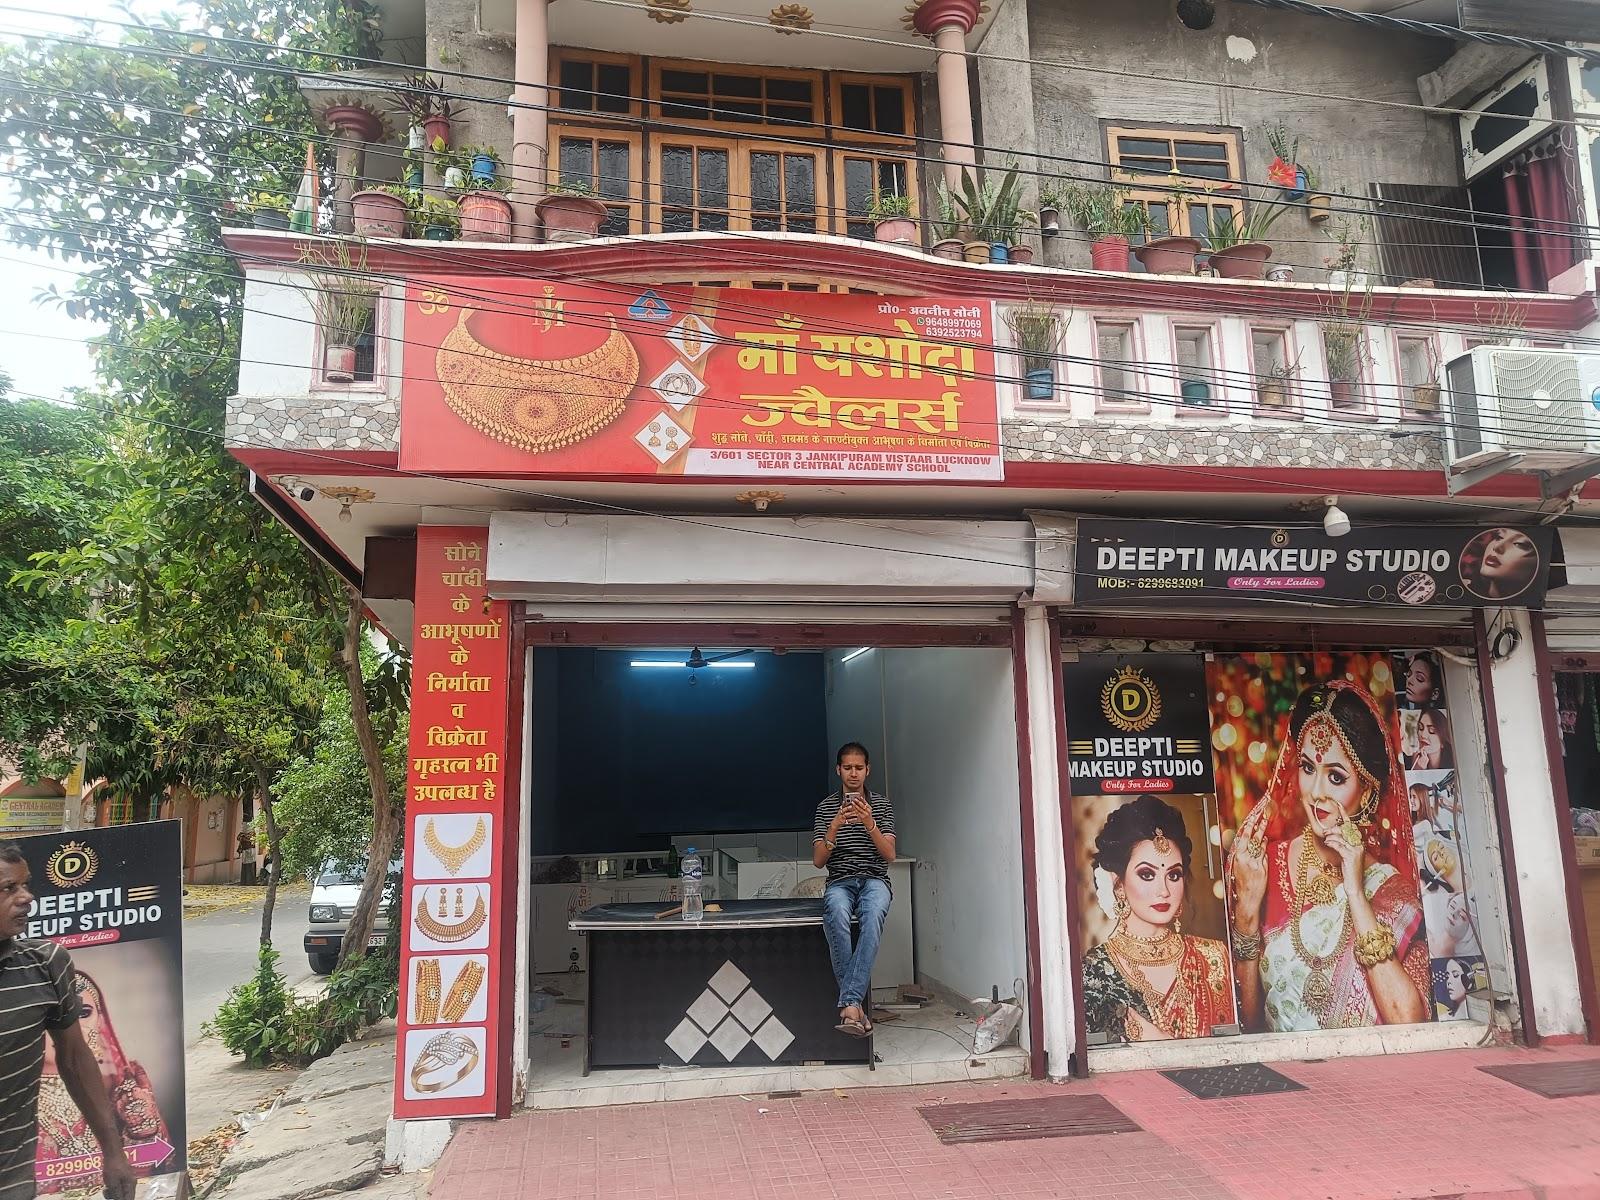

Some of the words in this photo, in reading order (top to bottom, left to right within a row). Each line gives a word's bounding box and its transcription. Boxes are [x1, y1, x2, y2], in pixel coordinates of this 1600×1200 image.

[952, 306, 981, 318] सोनी
[925, 317, 982, 329] 9648997069
[925, 328, 983, 338] 6392523794
[735, 313, 803, 375] माँ
[811, 319, 977, 387] यशोदा
[739, 385, 964, 434] ज्वैलर्स
[811, 432, 820, 444] के
[906, 434, 914, 446] के
[710, 451, 742, 460] 3/601
[747, 451, 791, 460] SECTOR
[795, 452, 802, 460] 3
[806, 453, 882, 463] JANKIPURAM
[886, 455, 932, 464] VISTAAR
[936, 456, 991, 465] LUCKNOW
[758, 461, 789, 469] NEAR
[793, 461, 844, 471] CENTRAL
[848, 462, 903, 472] ACADEMY
[907, 463, 951, 473] SCHOOL
[444, 542, 482, 561] सोने
[1097, 547, 1204, 571] DEEPTI
[1214, 548, 1338, 572] MAKEUP
[1346, 550, 1450, 572] STUDIO
[442, 566, 484, 586] चांदी
[1233, 577, 1260, 588] Only
[1263, 578, 1282, 586] For
[1284, 577, 1319, 586] Ladies
[450, 593, 472, 612] के
[421, 619, 502, 644] आभूषणों
[448, 645, 470, 665] के
[426, 671, 492, 692] निर्माता
[1121, 689, 1141, 711] D
[450, 703, 467, 718] व
[426, 726, 489, 746] विक्रेता
[1094, 737, 1173, 757] DEEPTI
[413, 757, 472, 779] गृहरत्न
[475, 752, 499, 773] भी
[1068, 761, 1137, 778] MAKEUP
[1142, 759, 1204, 777] STUDIO
[413, 784, 479, 801] उपलब्ध
[481, 778, 497, 801] है
[1105, 780, 1125, 791] Only
[1128, 780, 1141, 789] For
[1143, 780, 1170, 788] Ladies
[64, 857, 81, 874] D
[79, 905, 162, 931] STUDIO
[57, 936, 77, 947] For
[79, 931, 114, 943] Ladies
[46, 1149, 138, 1177] 8299681
